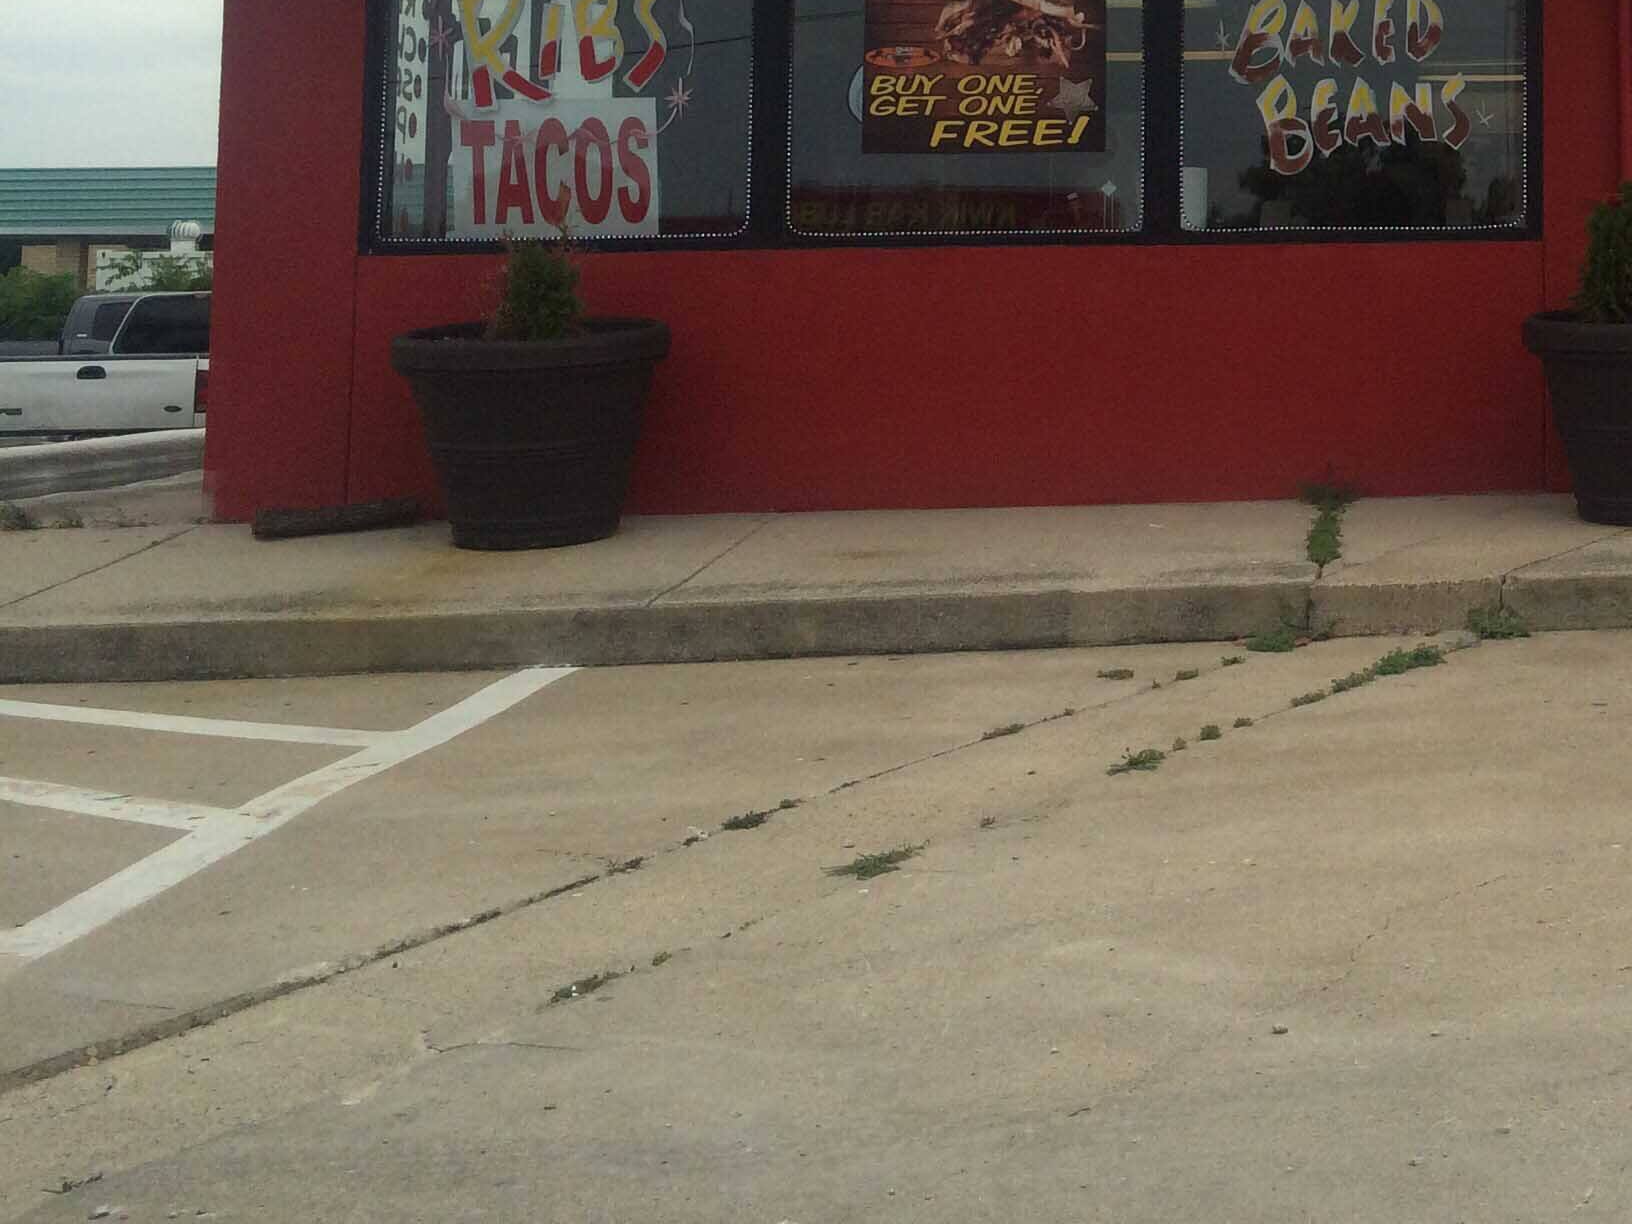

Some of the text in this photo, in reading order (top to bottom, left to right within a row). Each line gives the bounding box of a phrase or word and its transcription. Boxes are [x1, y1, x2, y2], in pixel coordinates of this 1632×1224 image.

[870, 74, 1044, 97] BUY ONE,
[869, 95, 1042, 118] GET ONE
[1256, 71, 1471, 176] BEANS
[929, 114, 1091, 149] FREE!
[459, 116, 652, 226] TACOS
